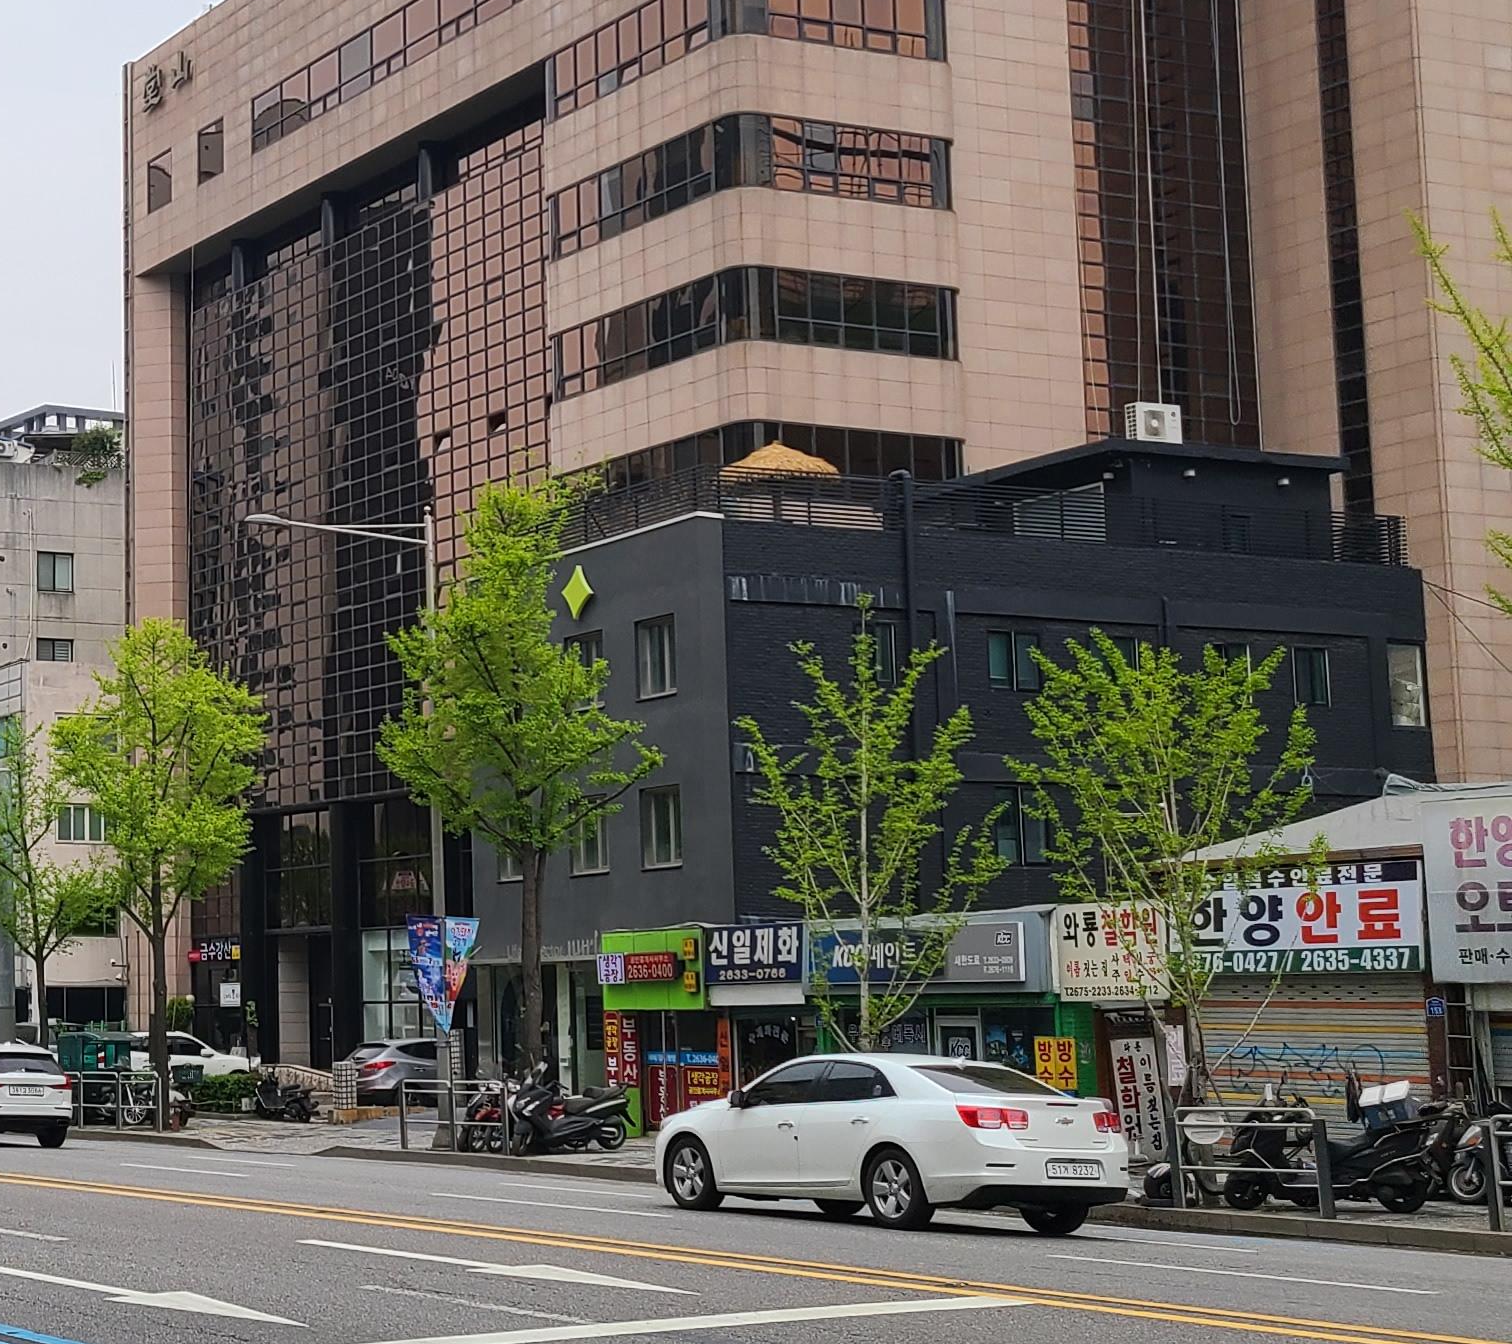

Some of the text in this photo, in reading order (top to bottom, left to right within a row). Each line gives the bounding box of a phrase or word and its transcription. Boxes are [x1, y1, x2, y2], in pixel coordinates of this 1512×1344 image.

[708, 927, 799, 966] 신일제화
[1063, 911, 1098, 947] 와룡
[200, 940, 231, 961] 금수강산
[1301, 947, 1410, 972] 2635-4337
[1066, 961, 1081, 977] 이름
[1038, 1041, 1054, 1084] 방수
[1057, 1041, 1074, 1087] 방수
